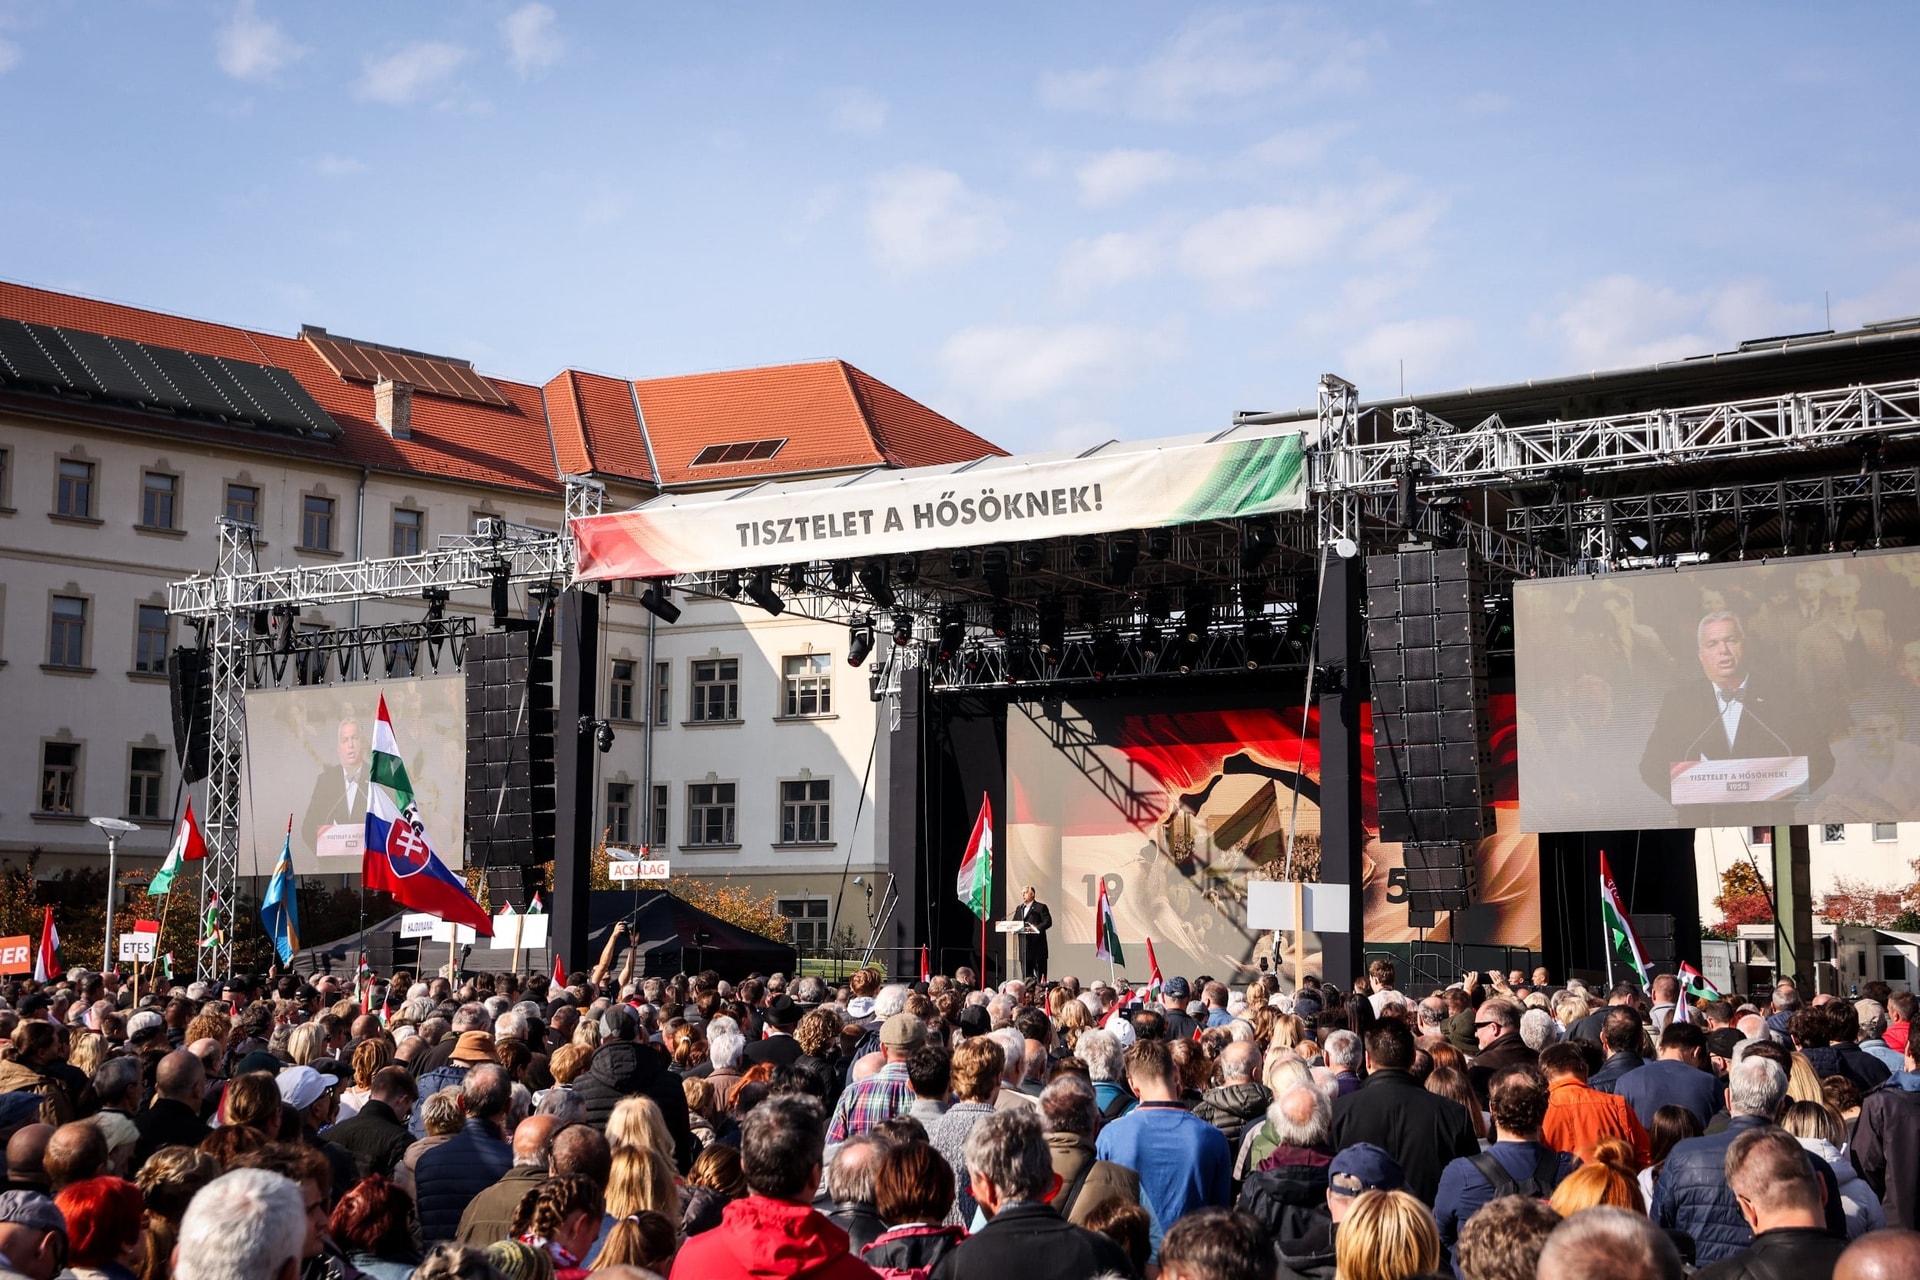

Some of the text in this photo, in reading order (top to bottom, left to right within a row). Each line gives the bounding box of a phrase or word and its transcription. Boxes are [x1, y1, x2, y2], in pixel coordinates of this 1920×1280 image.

[736, 483, 1103, 547] TISZTELET A HŐSÖKNEK!
[1690, 773, 1728, 782] TISZTELET
[1728, 782, 1748, 791] 1956
[614, 864, 665, 876] ACSALAG
[1081, 872, 1124, 907] 19
[123, 942, 150, 954] ETES
[0, 946, 28, 965] ER
